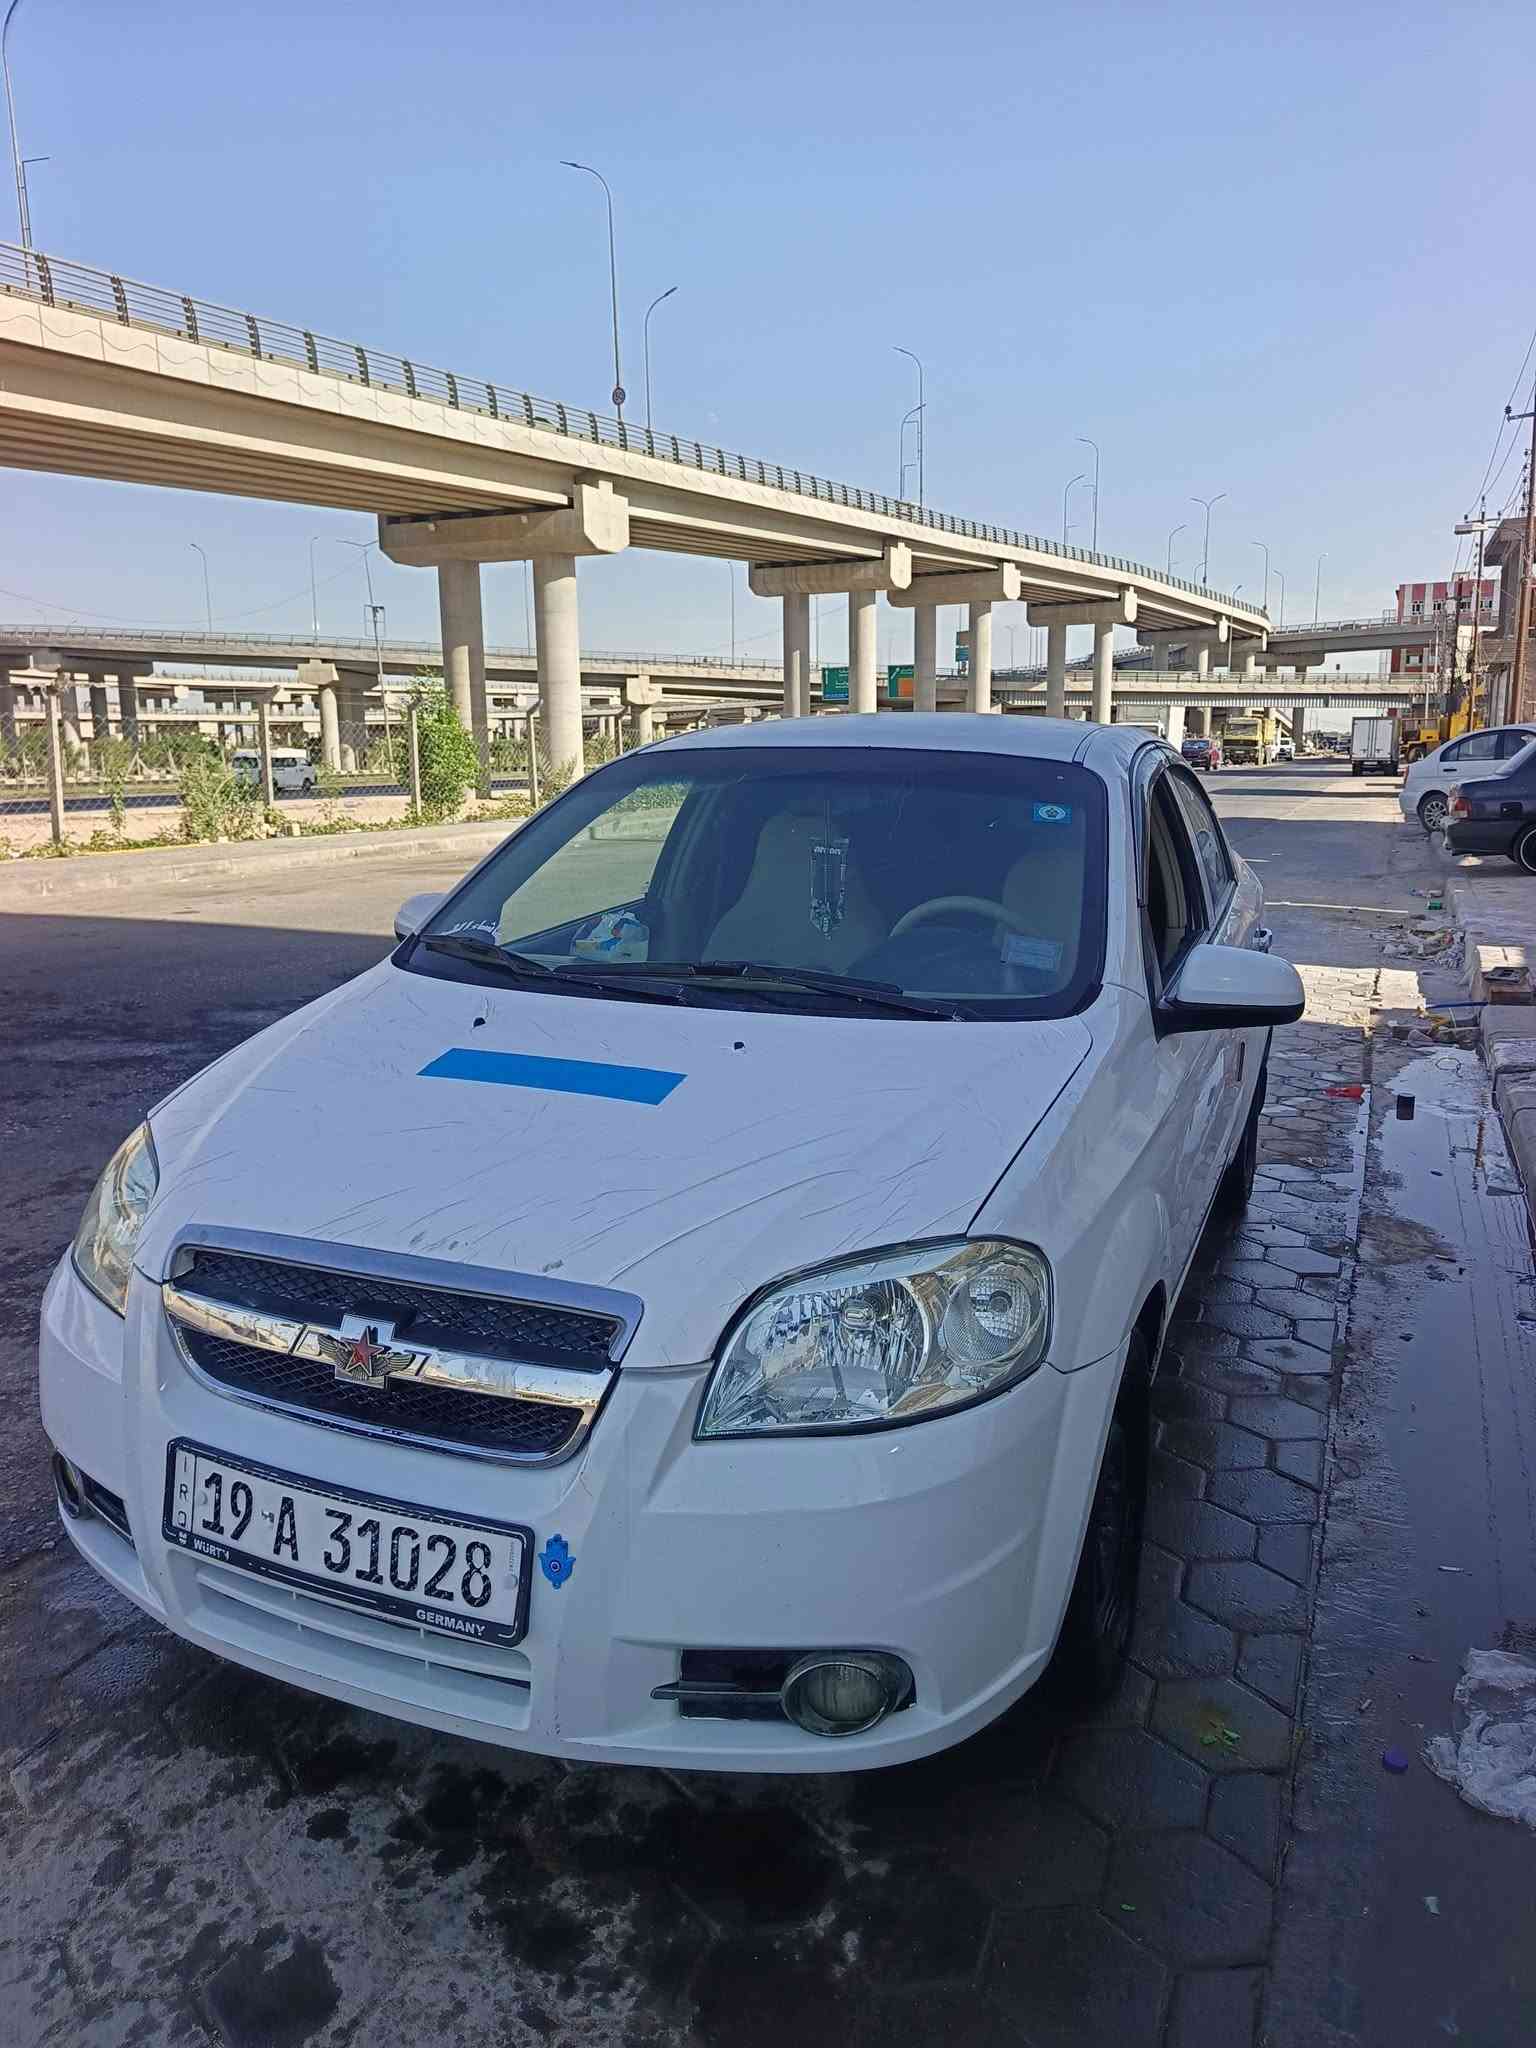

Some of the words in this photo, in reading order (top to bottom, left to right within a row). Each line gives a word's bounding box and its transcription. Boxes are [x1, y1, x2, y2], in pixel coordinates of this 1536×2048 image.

[202, 1472, 254, 1541] 19
[273, 1496, 299, 1562] A
[324, 1508, 492, 1608] 31028
[416, 1609, 486, 1636] GERMANY
